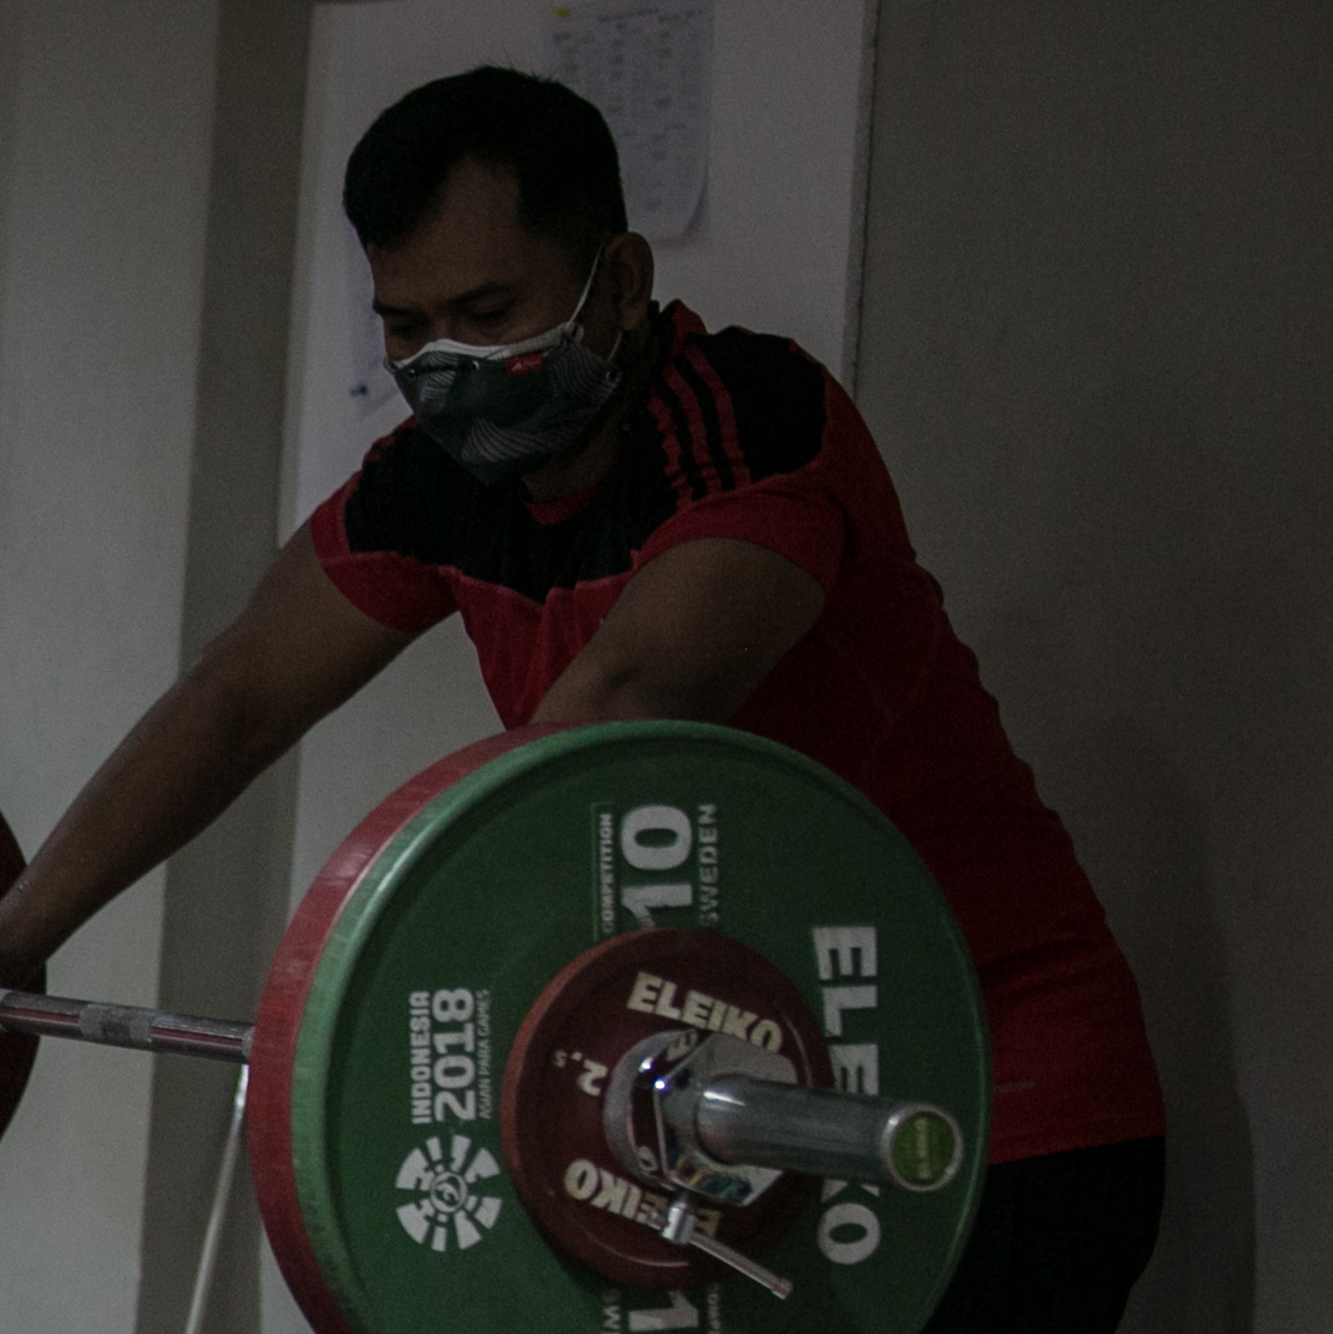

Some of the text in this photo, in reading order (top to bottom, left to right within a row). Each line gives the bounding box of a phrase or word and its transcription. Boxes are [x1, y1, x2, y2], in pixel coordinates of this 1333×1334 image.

[620, 804, 694, 931] 10
[408, 990, 432, 1125] INDONESIA
[432, 987, 476, 1123] 2018
[476, 988, 491, 1037] GAMES
[478, 1039, 491, 1076] PARA
[626, 970, 783, 1053] ELEIKO
[552, 1048, 609, 1097] 2.5
[812, 925, 882, 1265] ELEO
